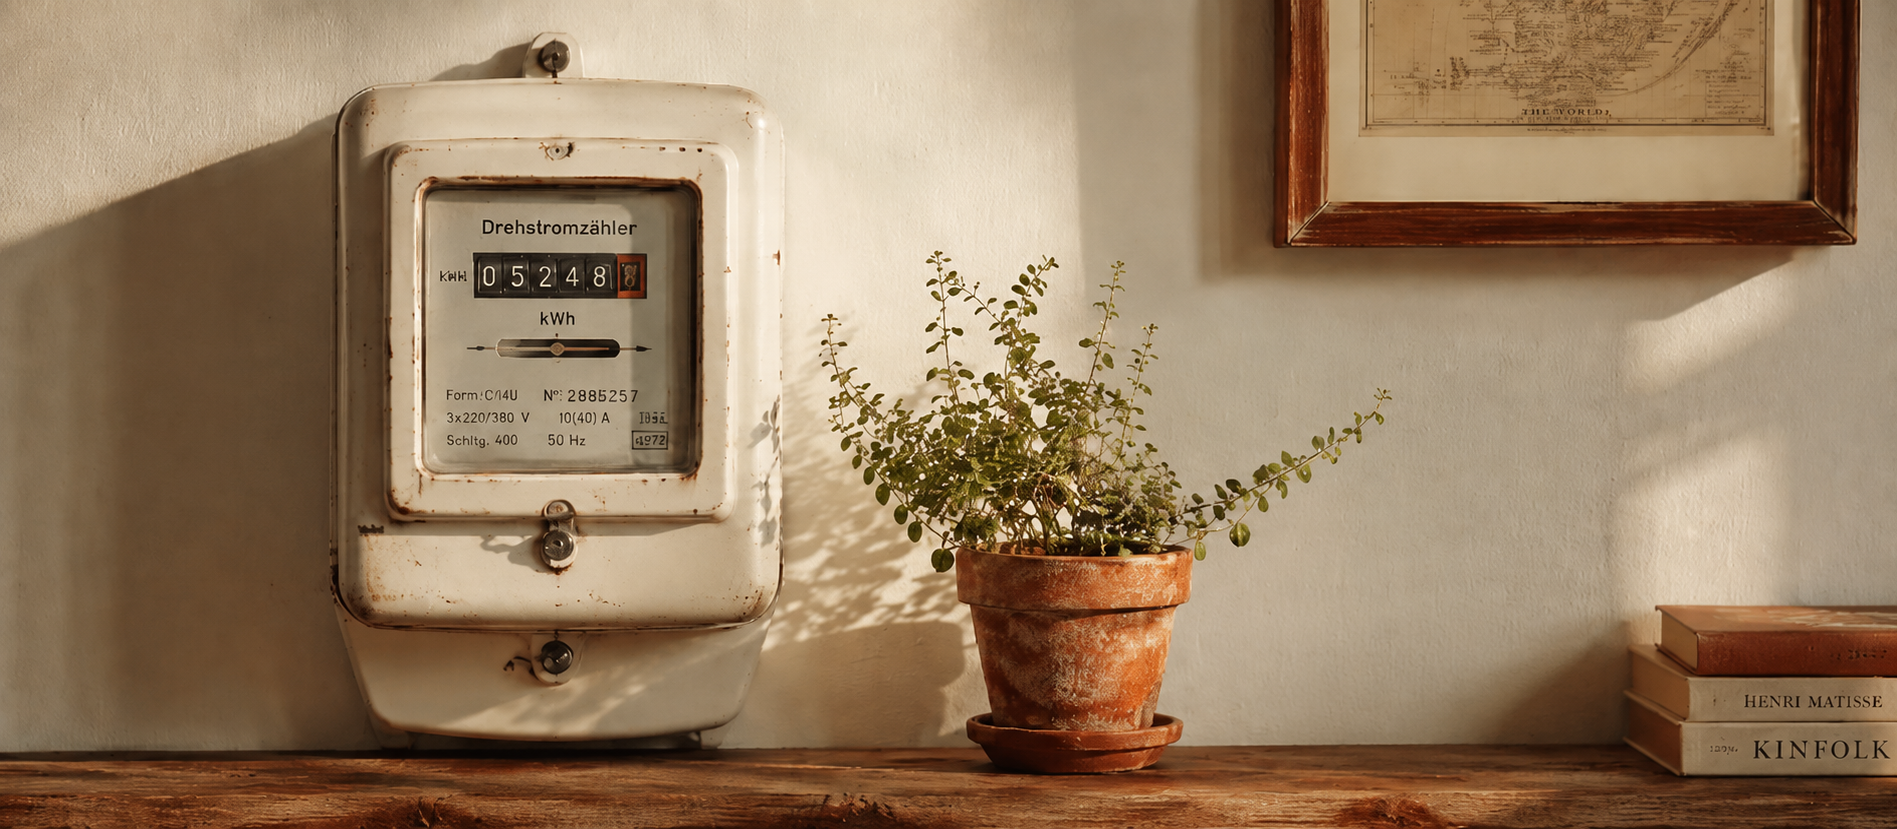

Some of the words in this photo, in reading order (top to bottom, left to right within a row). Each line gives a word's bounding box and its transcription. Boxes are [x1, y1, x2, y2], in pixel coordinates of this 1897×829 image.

[481, 219, 638, 236] Drehstromzähler
[539, 311, 576, 326] kWh
[446, 411, 515, 424] 3x220/380
[521, 411, 530, 423] V
[559, 411, 597, 426] 10(40)
[601, 412, 611, 424] A
[446, 434, 490, 449] Schltg.
[494, 434, 518, 446] 400
[547, 433, 565, 446] 50
[569, 434, 587, 446] Hz
[1744, 694, 1801, 708] HENRI
[1807, 694, 1883, 708] MATISSE
[1753, 739, 1891, 760] KINFOLK
